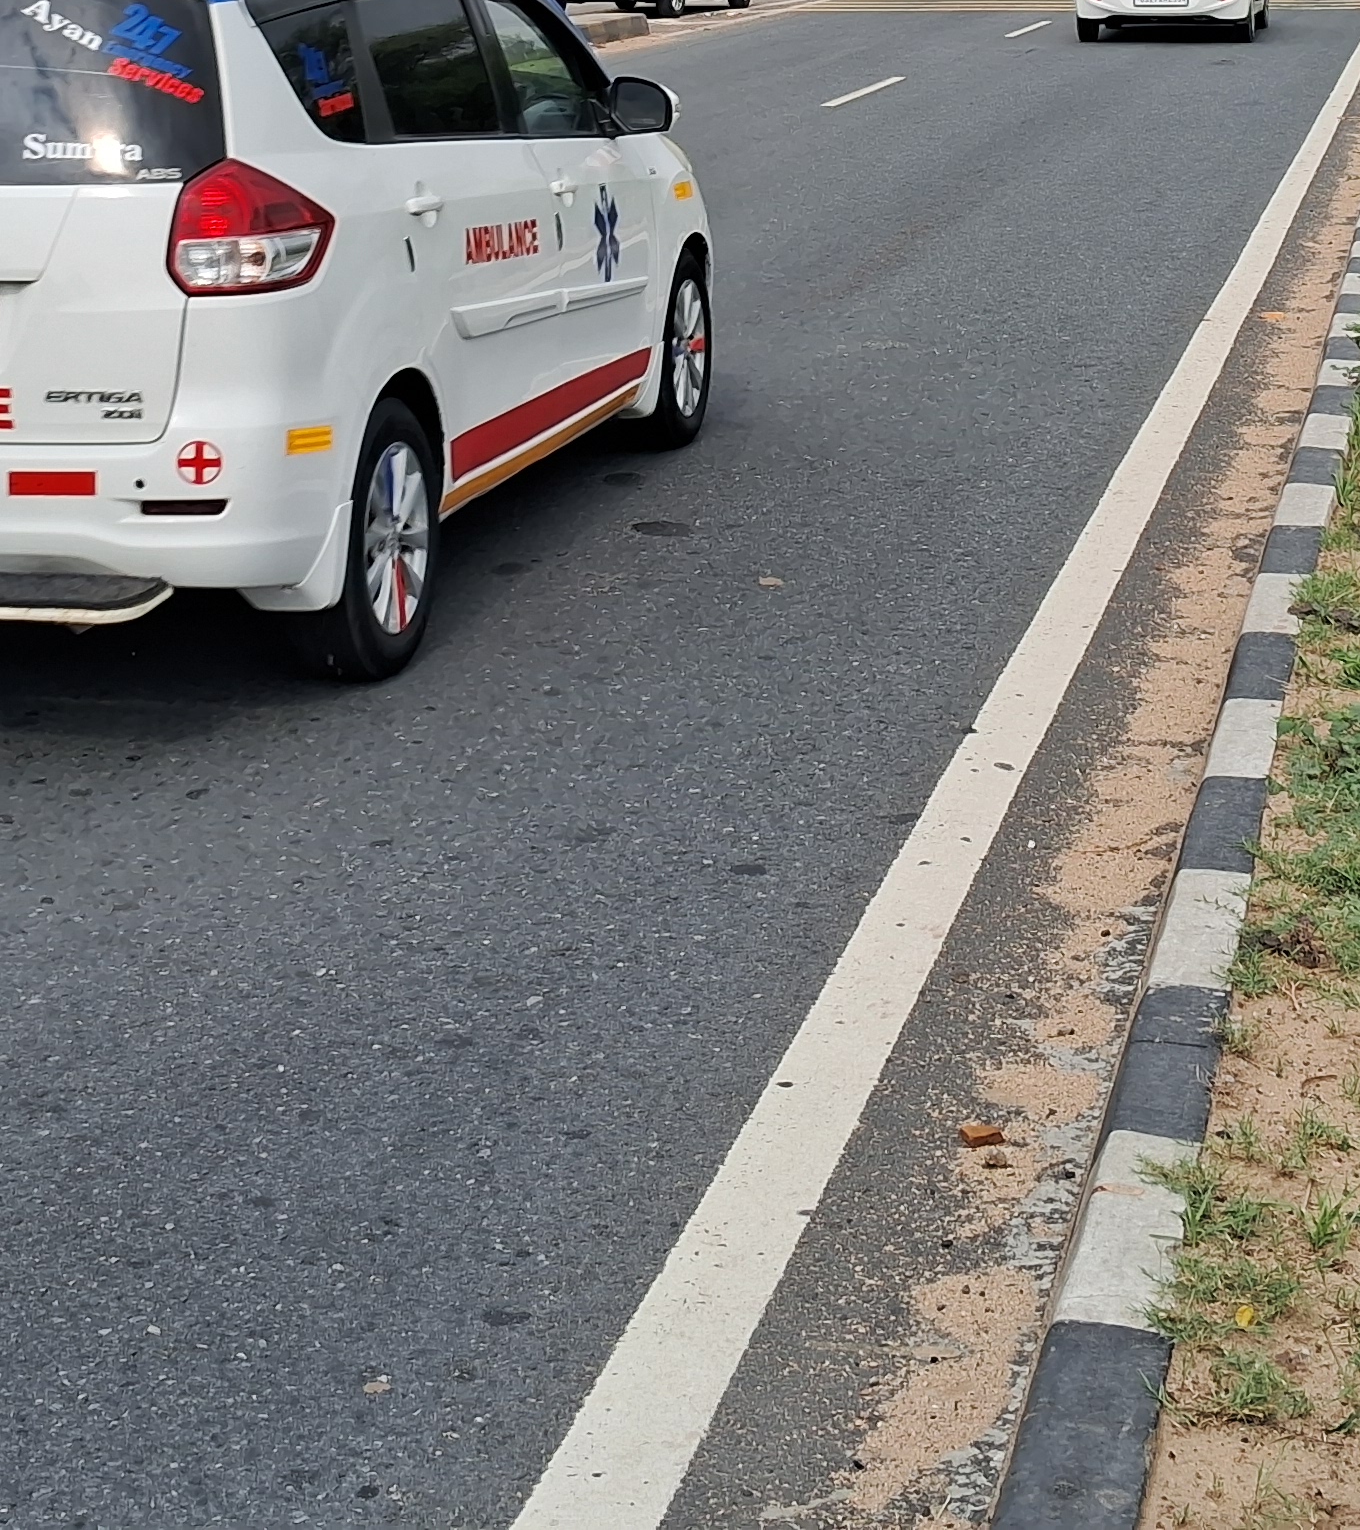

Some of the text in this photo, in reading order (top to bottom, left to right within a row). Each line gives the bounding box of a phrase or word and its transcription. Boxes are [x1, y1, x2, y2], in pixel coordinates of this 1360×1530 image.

[20, 0, 103, 52] Ayan
[107, 56, 205, 104] Services
[136, 167, 183, 180] ABS
[465, 218, 540, 266] AMBULANCE
[45, 390, 143, 404] ERTIGA
